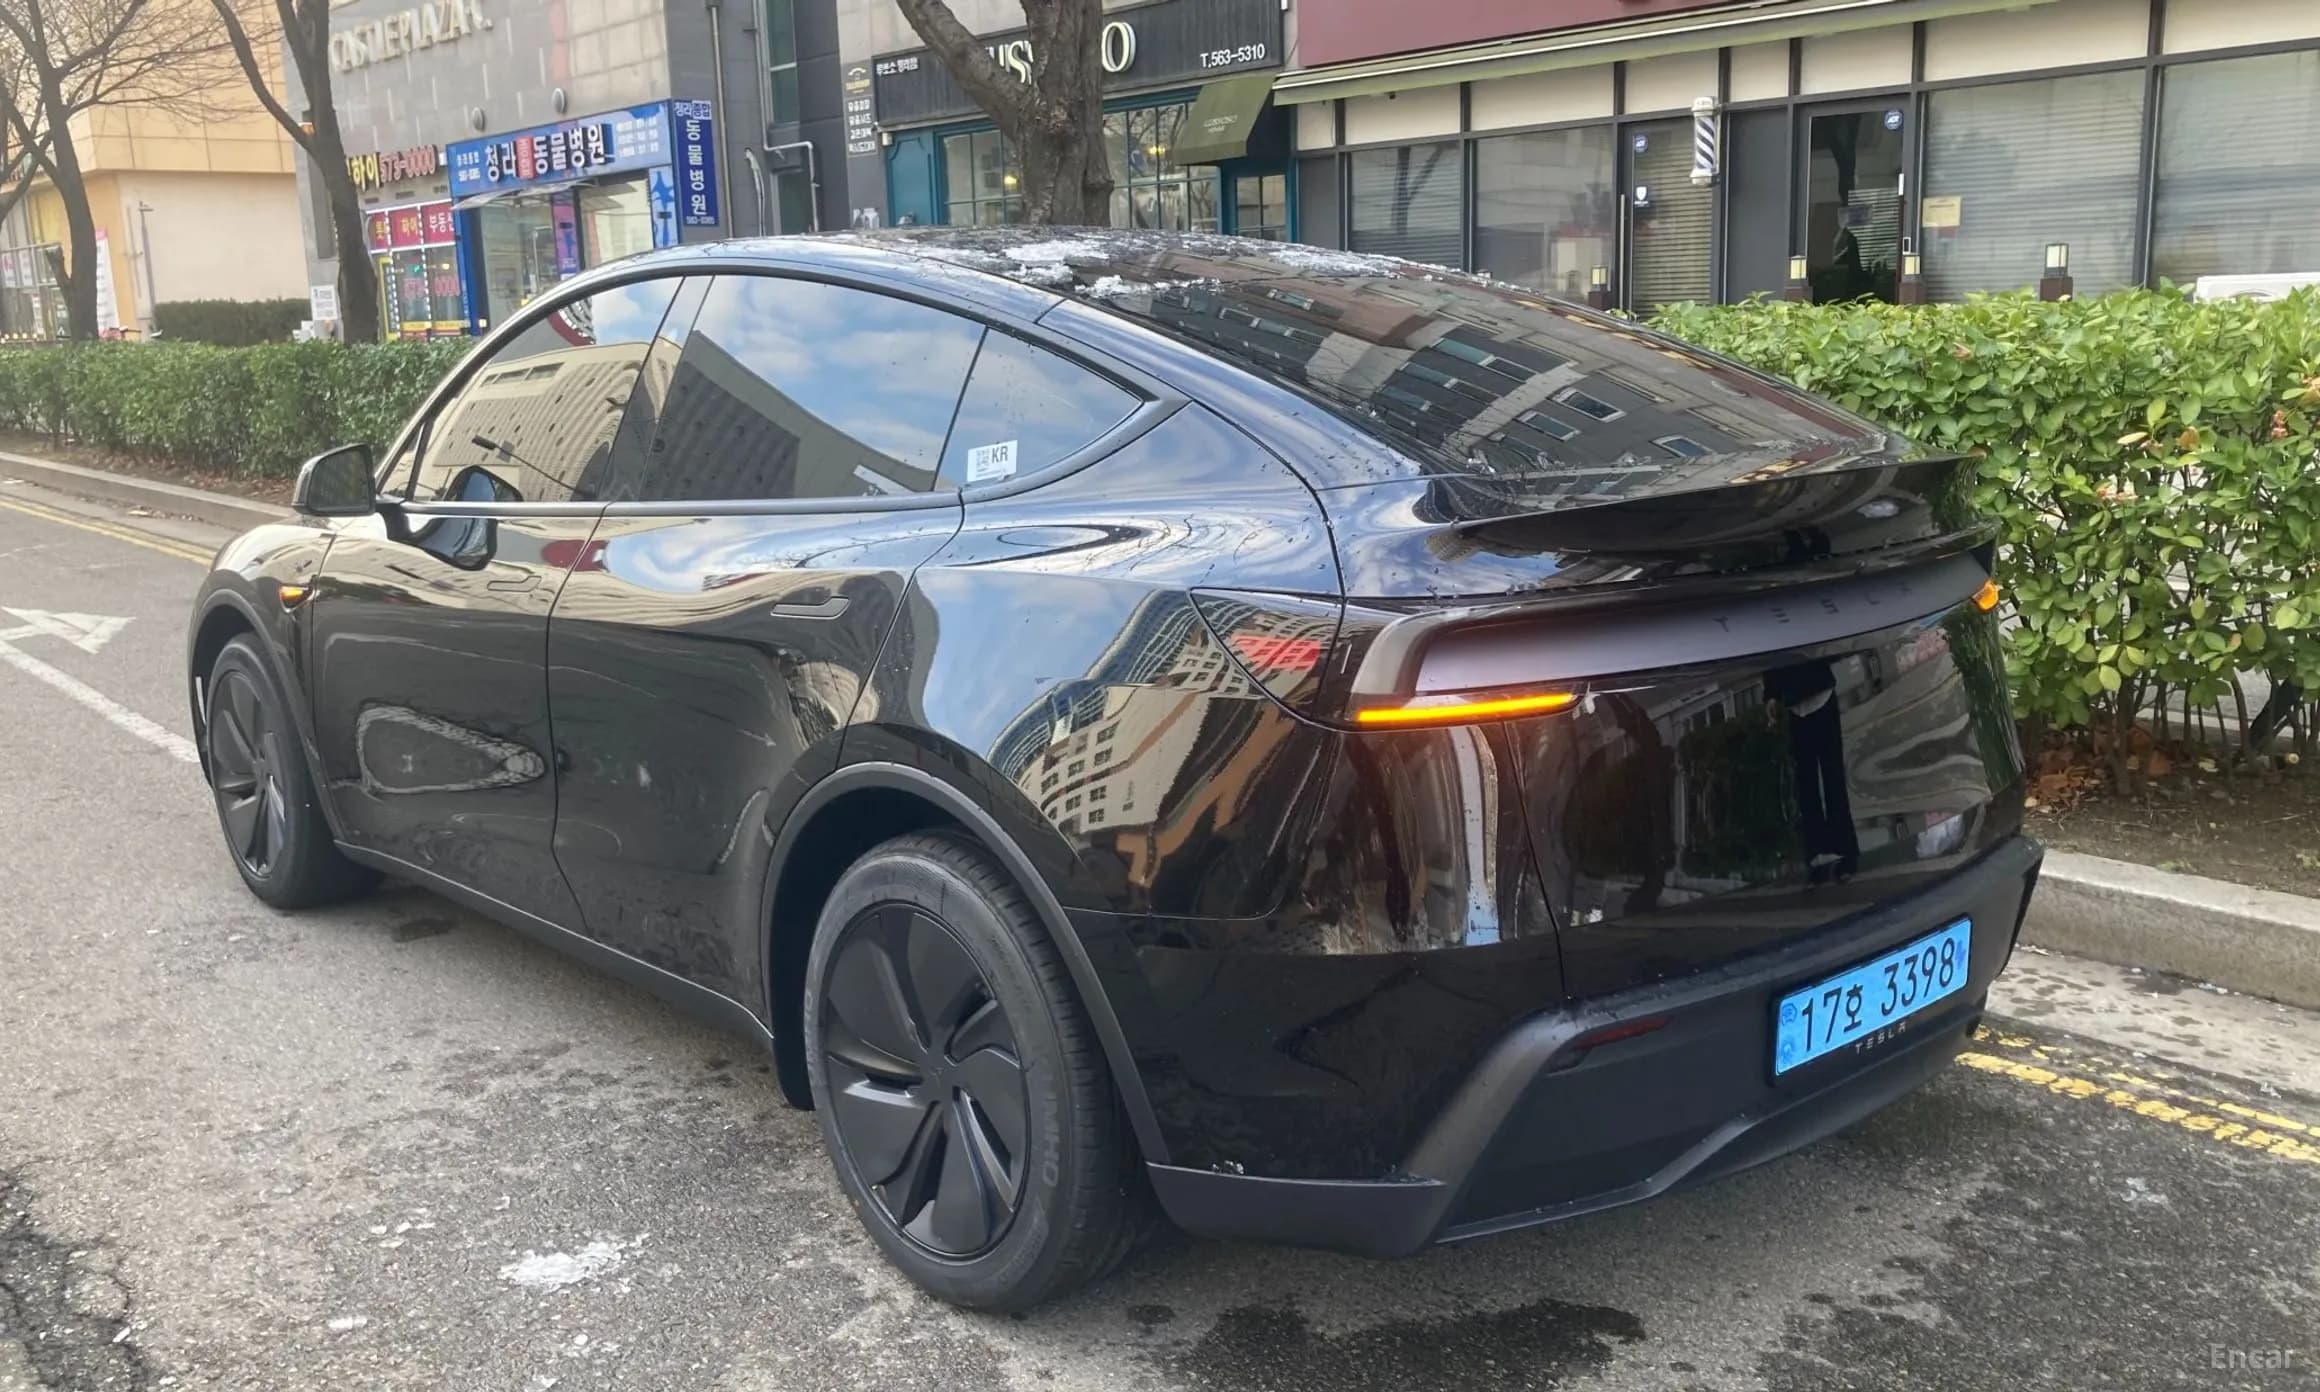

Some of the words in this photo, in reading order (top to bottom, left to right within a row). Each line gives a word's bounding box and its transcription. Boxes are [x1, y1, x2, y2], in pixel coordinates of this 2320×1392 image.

[1200, 43, 1265, 68] T.563-5310
[346, 152, 379, 192] 하이
[485, 143, 517, 182] 청라
[533, 124, 606, 174] 동물병원
[686, 119, 707, 216] 동물병원
[991, 445, 1008, 464] KR
[1801, 983, 1864, 1051] 17호
[1881, 937, 1955, 1016] 3398
[1855, 1022, 1906, 1054] TESLA
